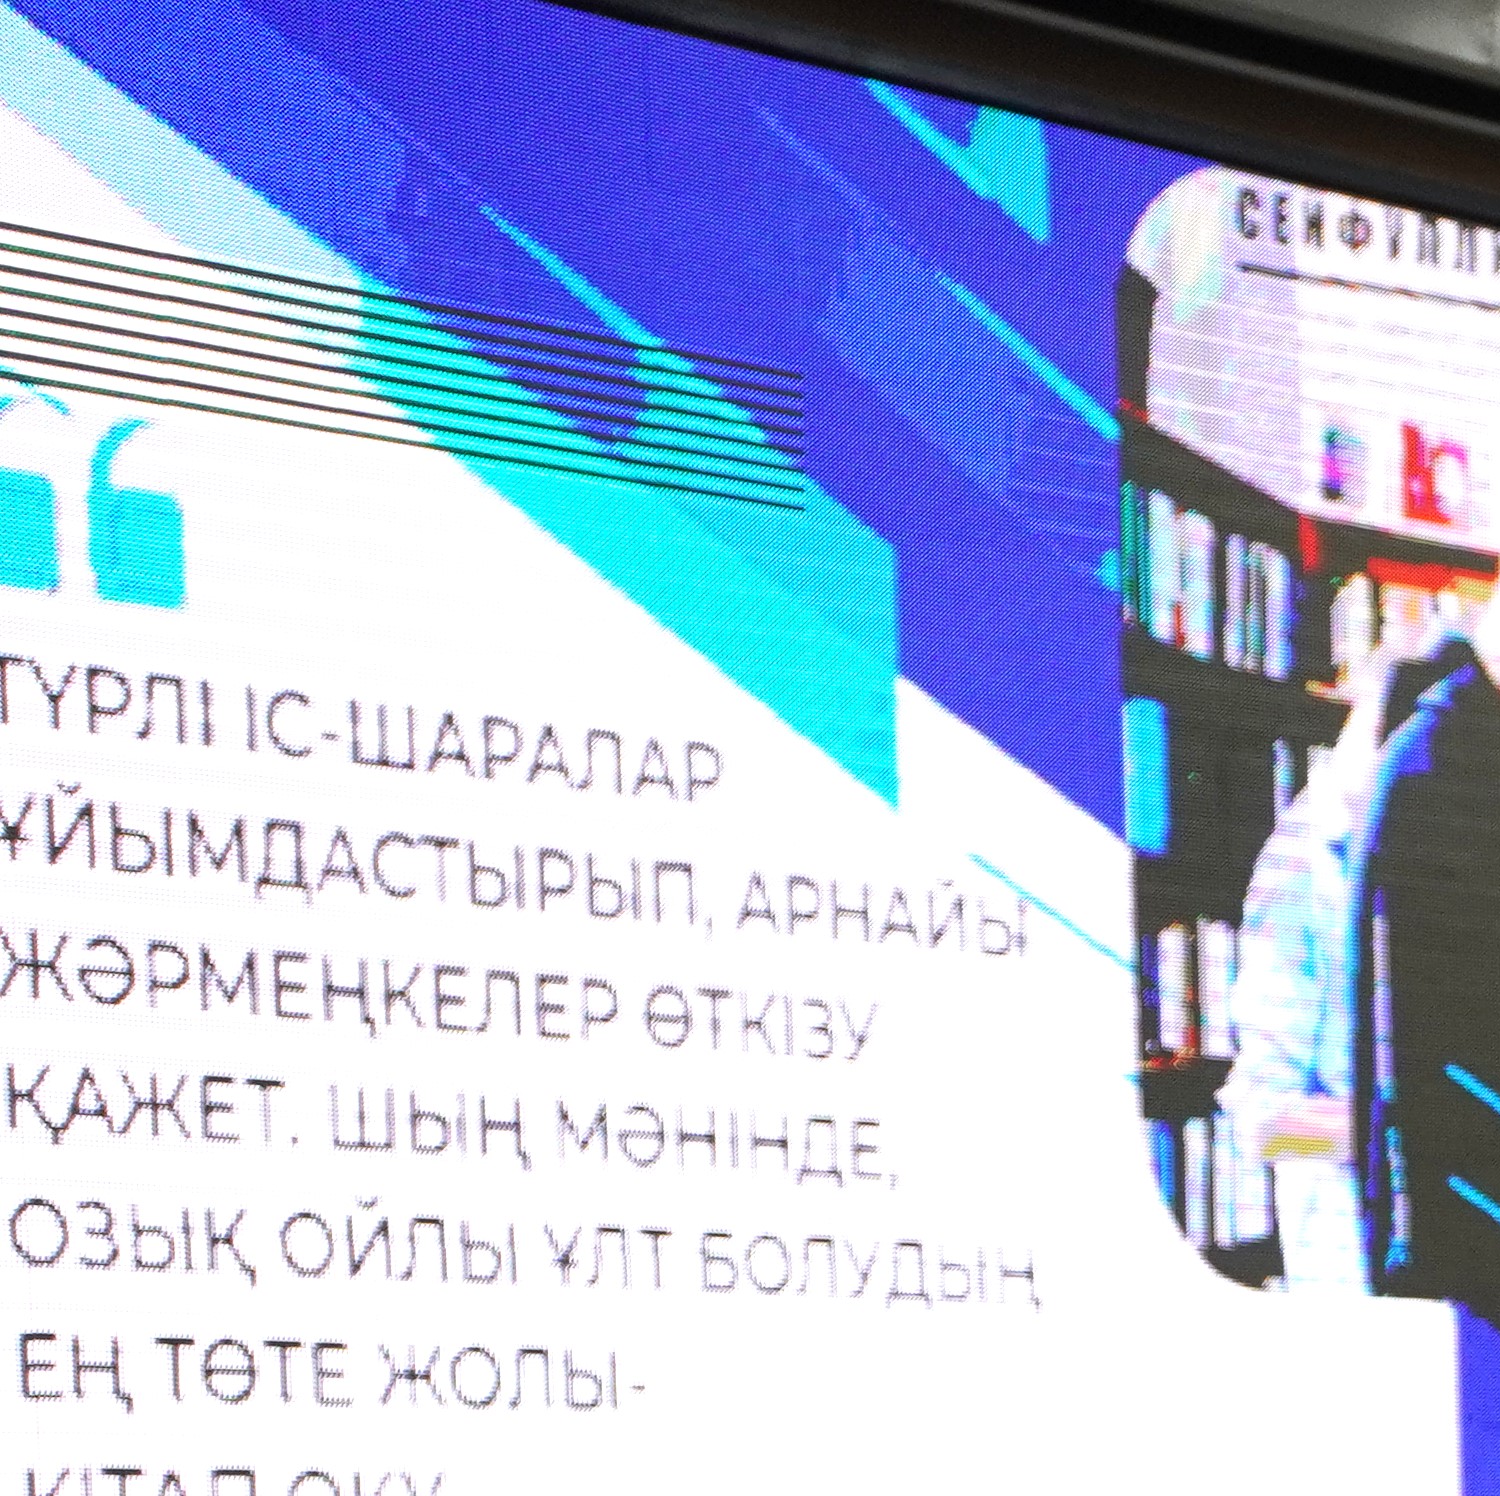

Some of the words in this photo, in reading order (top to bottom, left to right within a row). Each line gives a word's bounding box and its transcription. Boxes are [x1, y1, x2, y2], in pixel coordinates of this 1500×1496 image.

[0, 654, 213, 746] ТҮРЛІ
[246, 682, 724, 801] ІС-ШАРАЛАР
[0, 781, 714, 939] ҰЙЫМДАСТЫРЫП,
[739, 872, 1034, 957] АРНАЙЫ
[0, 928, 618, 1039] ЖӘРМЕҢКЕЛЕР
[644, 985, 878, 1061] ӨТКІЗУ
[7, 1065, 297, 1145] ҚАЖЕТ.
[330, 1084, 531, 1172] ШЫҢ
[557, 1101, 899, 1190] МӘНІНДЕ,
[9, 1197, 257, 1286] ОЗЫҚ
[280, 1195, 518, 1284] ОЙЛЫ
[544, 1223, 672, 1287] ҰЛТ
[701, 1231, 1040, 1306] БОЛУДЫҢ
[19, 1331, 134, 1413] ЕҢ
[154, 1336, 350, 1405] ТӨТЕ
